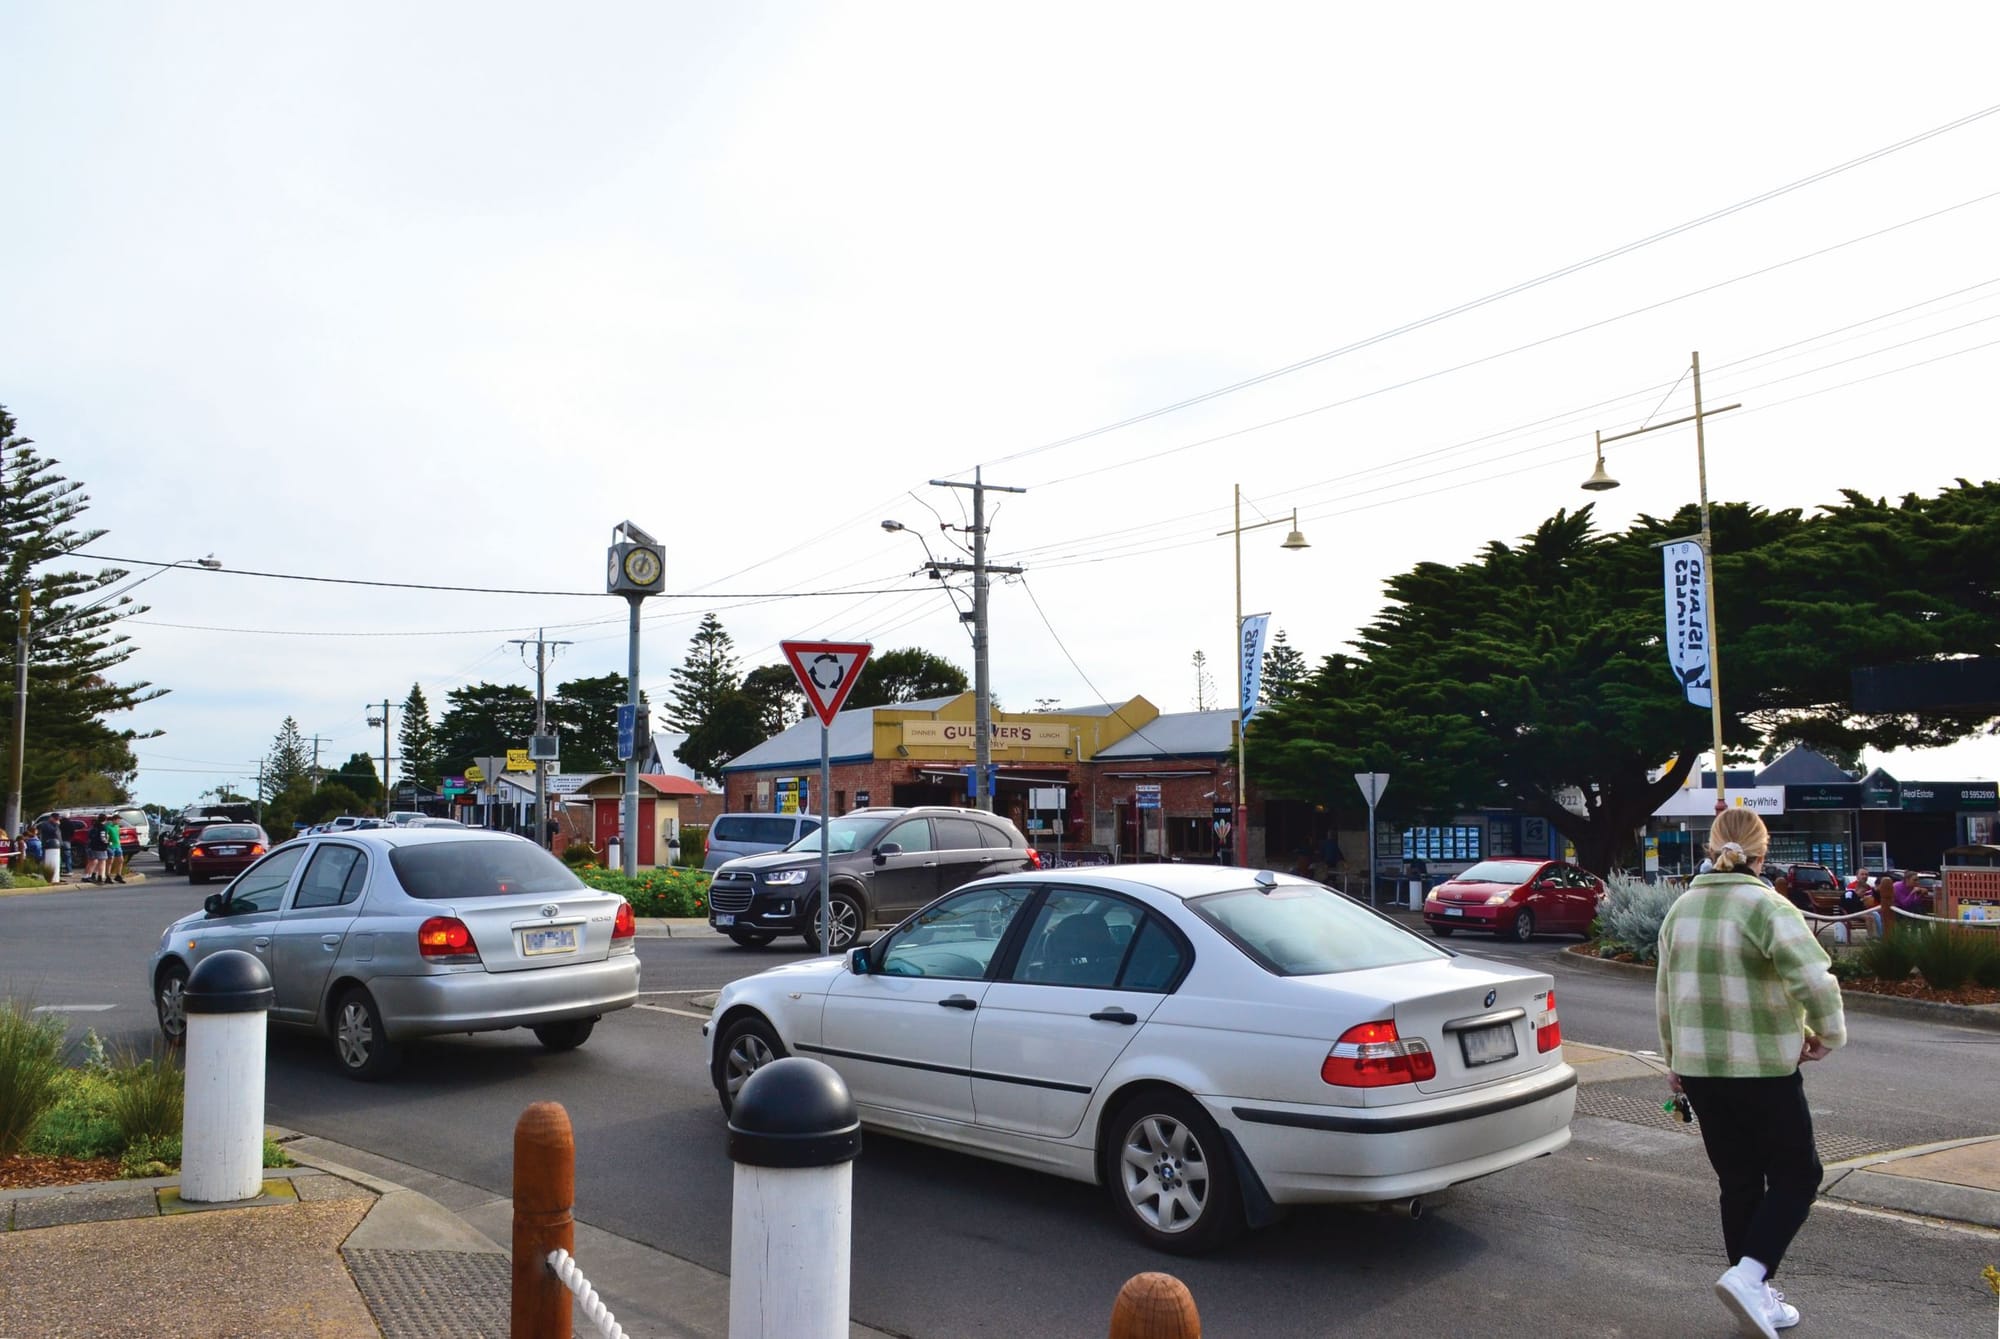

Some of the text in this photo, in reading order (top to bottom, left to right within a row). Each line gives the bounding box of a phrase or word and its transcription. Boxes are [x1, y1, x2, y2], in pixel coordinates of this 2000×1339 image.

[944, 726, 1032, 741] GULVER'S
[1903, 789, 1916, 799] Real
[1916, 789, 1934, 798] Estate
[1961, 790, 1968, 799] 03
